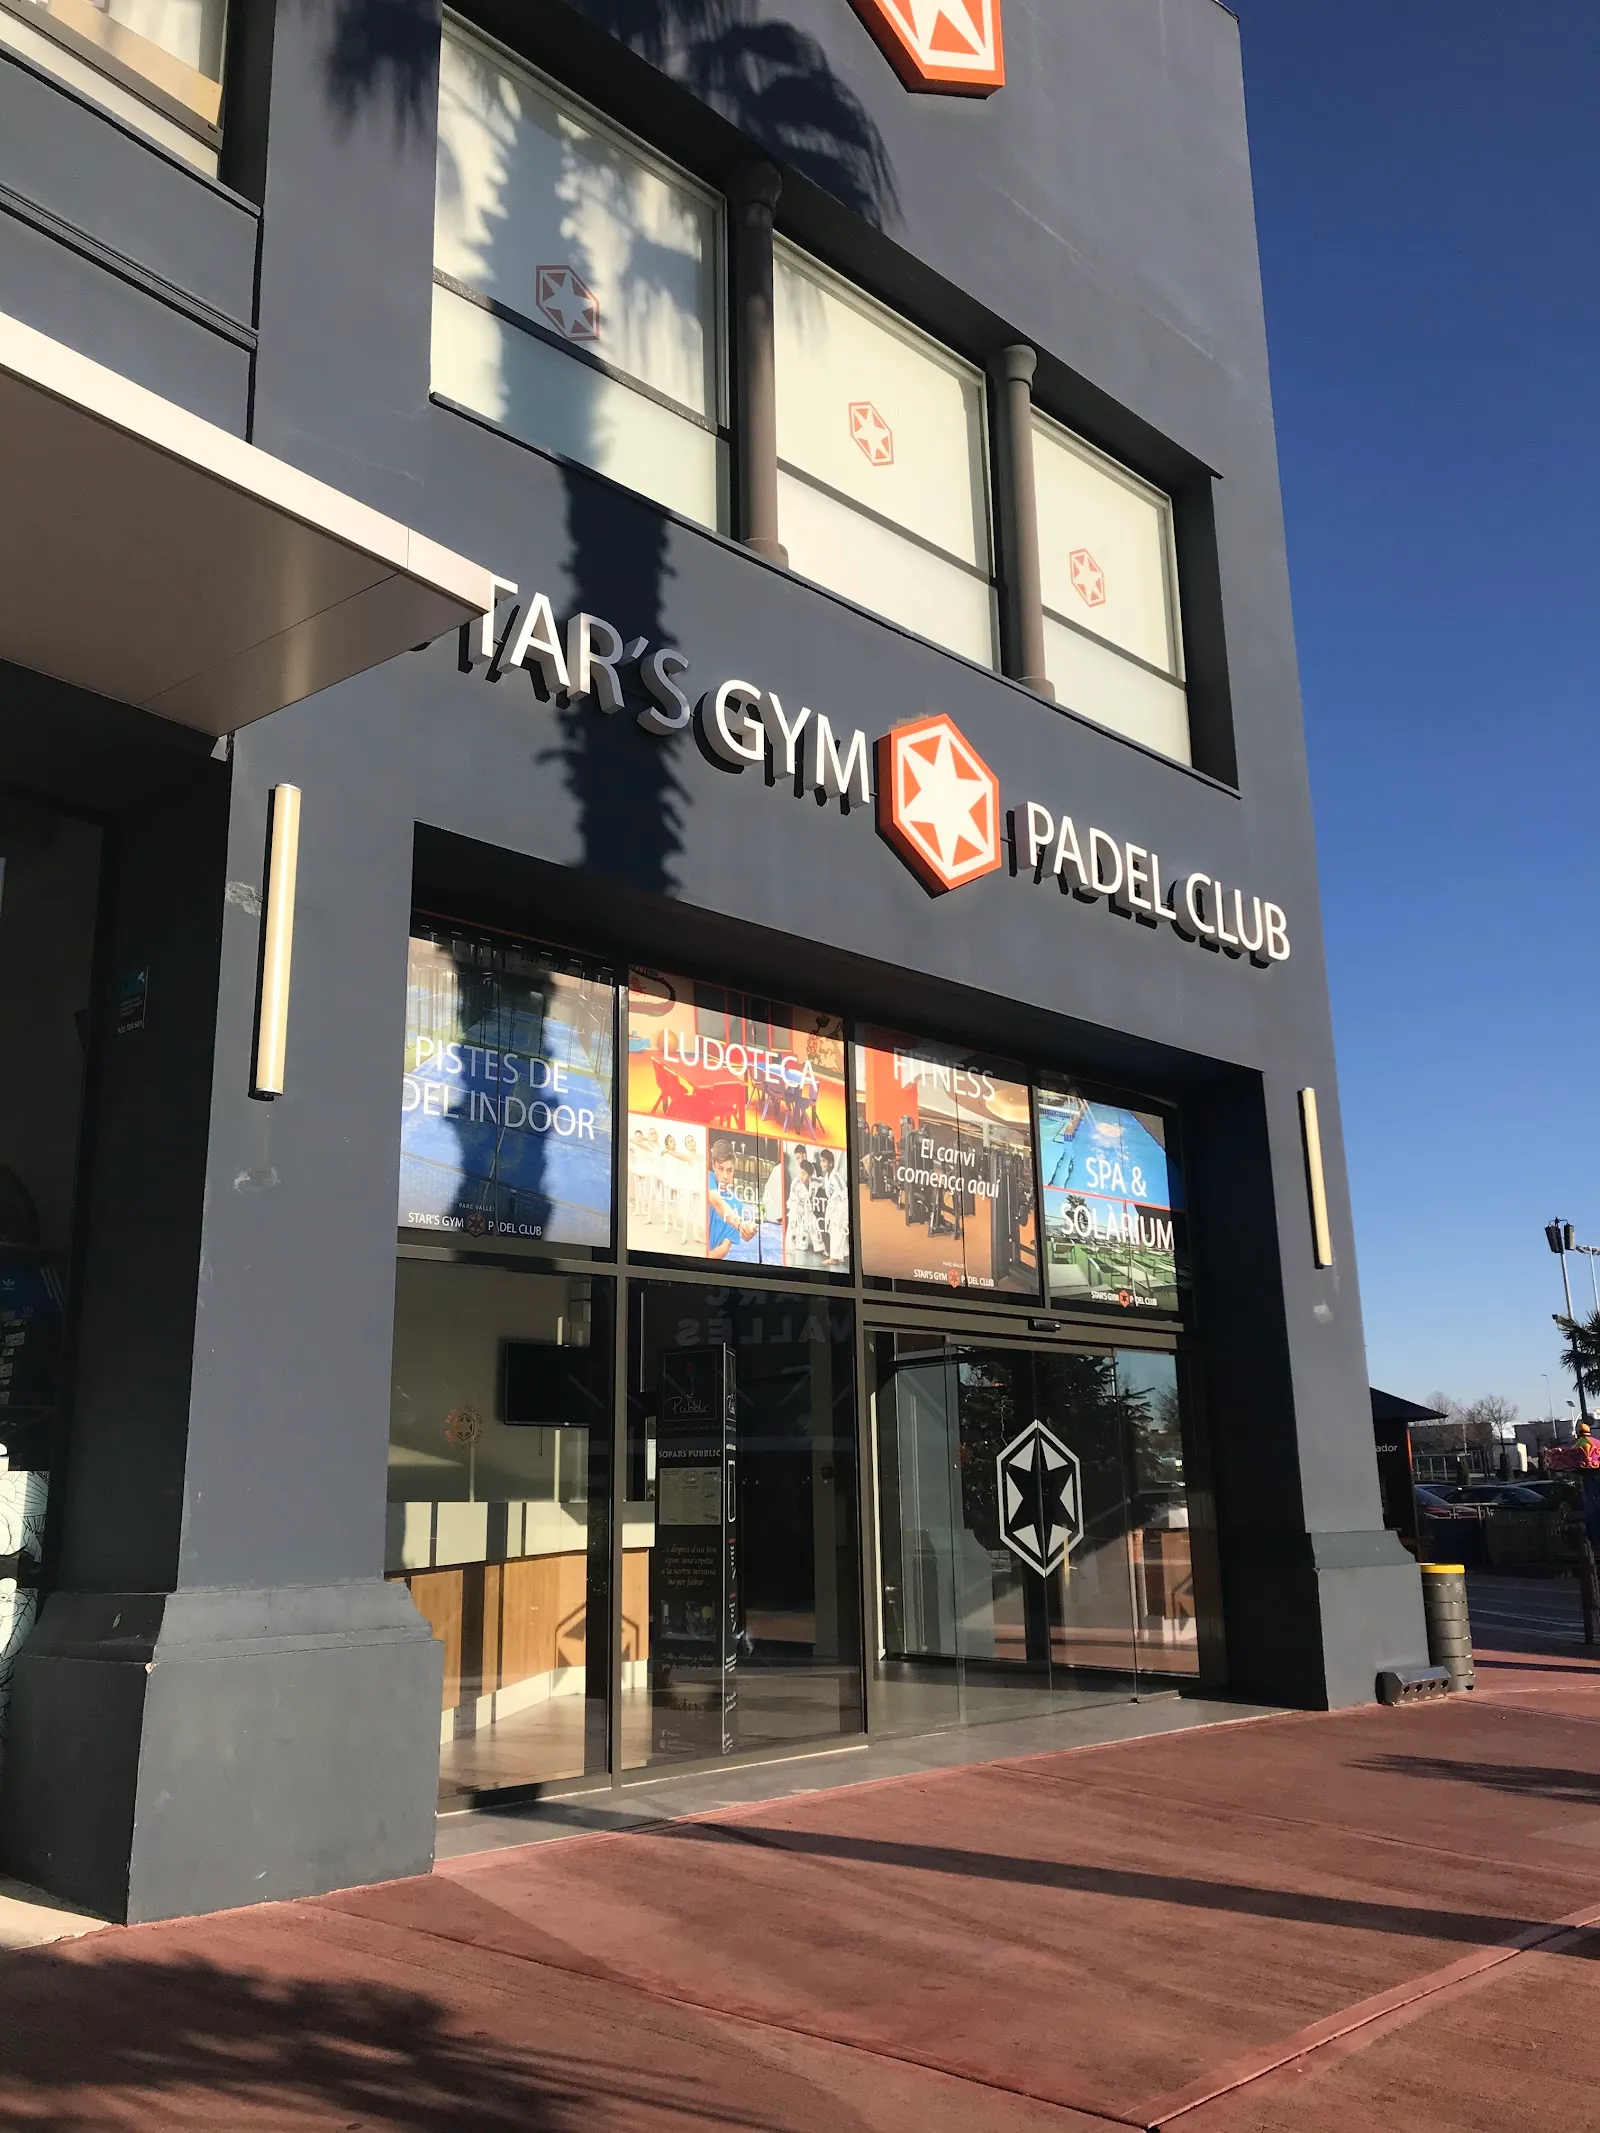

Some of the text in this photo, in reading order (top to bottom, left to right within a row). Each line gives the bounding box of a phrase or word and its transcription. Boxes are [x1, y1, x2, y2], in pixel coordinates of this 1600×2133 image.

[708, 679, 870, 805] GYM
[1022, 801, 1291, 962] PADEL CLUB
[415, 1035, 568, 1093] PISTES DE
[664, 1029, 818, 1092] LUDOTECA
[893, 1047, 996, 1102] FITNESS
[470, 1090, 594, 1139] INDOOR
[921, 1138, 976, 1168] El canvi
[897, 1166, 1001, 1200] comença aquí
[1086, 1157, 1147, 1198] SPA &
[407, 1211, 440, 1225] STAR'S
[442, 1215, 464, 1228] GYM
[519, 1223, 542, 1236] CLUB
[1060, 1203, 1175, 1250] SOLÀRIUM
[913, 1269, 933, 1280] STAR'S
[934, 1272, 948, 1281] GYM
[979, 1277, 995, 1287] CLUB
[658, 1449, 721, 1459] SOPARS PUBBLIC
[1375, 1444, 1398, 1452] ador
